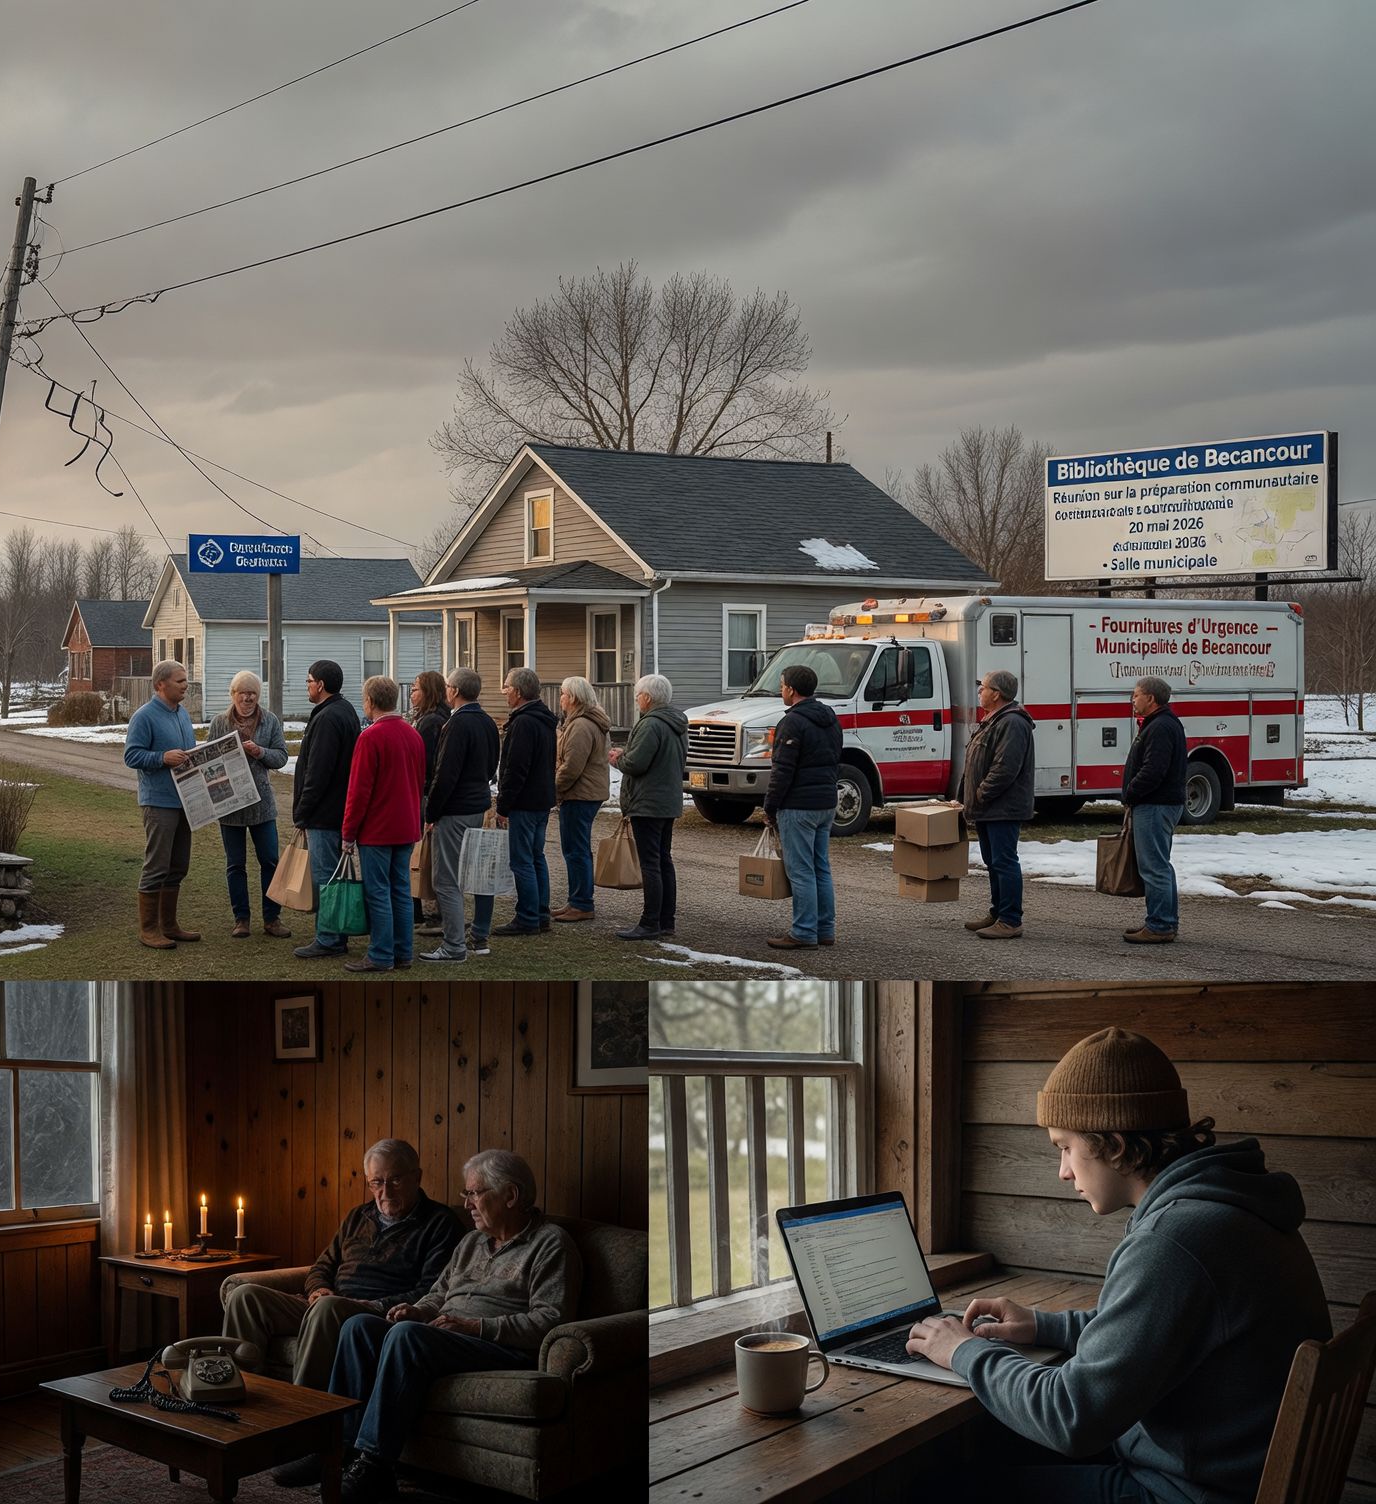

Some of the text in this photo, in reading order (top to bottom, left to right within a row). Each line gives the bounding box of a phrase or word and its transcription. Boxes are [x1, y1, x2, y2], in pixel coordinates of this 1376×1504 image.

[1057, 443, 1313, 480] Bibliothèque de Becancour
[1053, 472, 1319, 504] Réunion sur la préparation communautaire
[1129, 517, 1204, 534] 20 mai 2026
[1111, 554, 1218, 571] Salle municipale
[1101, 616, 1259, 638] Fournitures d'Urgence
[1182, 638, 1197, 655] de
[1202, 638, 1272, 655] Becancour
